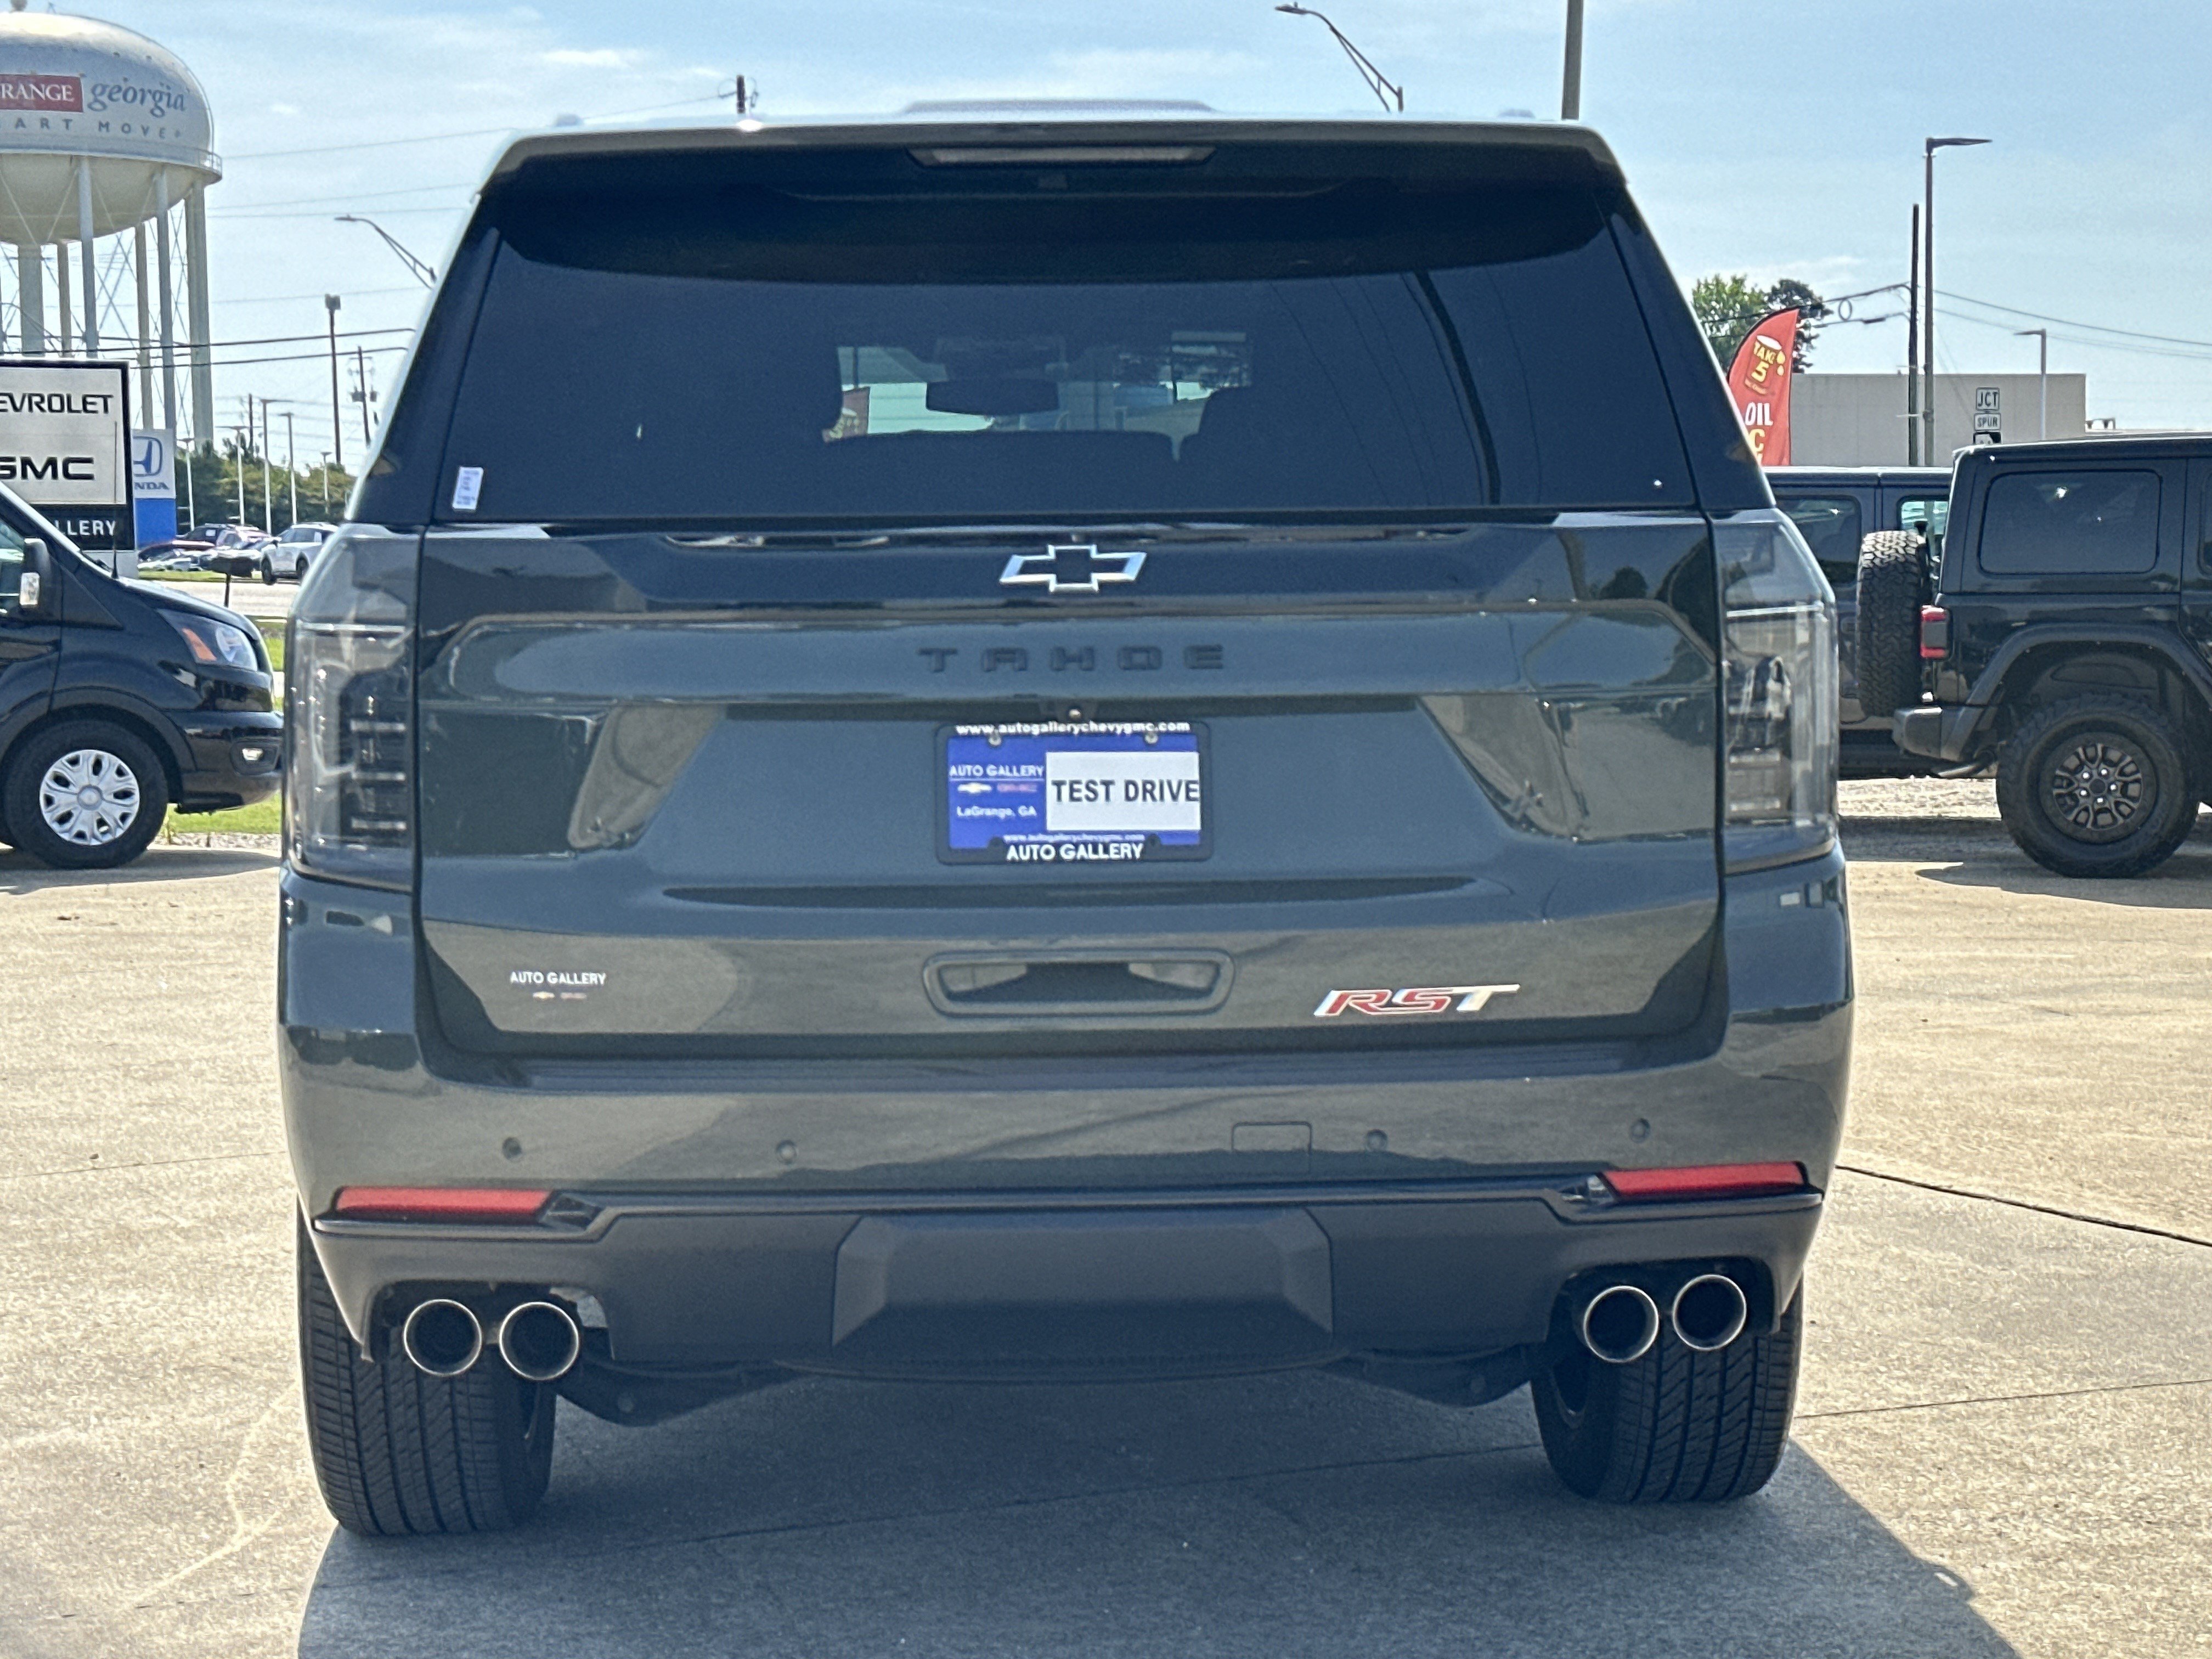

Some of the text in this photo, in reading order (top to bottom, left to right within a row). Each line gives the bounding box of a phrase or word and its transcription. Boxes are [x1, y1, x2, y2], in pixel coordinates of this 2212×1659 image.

[87, 83, 187, 118] georgia
[1751, 360, 1769, 382] 5
[1977, 391, 1998, 407] JCT
[1745, 402, 1774, 426] OIL
[1977, 416, 1998, 427] SPUR
[917, 645, 1224, 674] TAHOE
[956, 720, 1191, 736] www.autogallerychevygmc.com
[949, 764, 1044, 777] AUTO GALLERY
[1051, 778, 1200, 803] TEST DRIVE
[1018, 805, 1037, 816] GA
[1006, 843, 1144, 861] AUTO GALLERY
[510, 971, 607, 985] AUTO GALLERY
[1313, 983, 1521, 1017] RST
